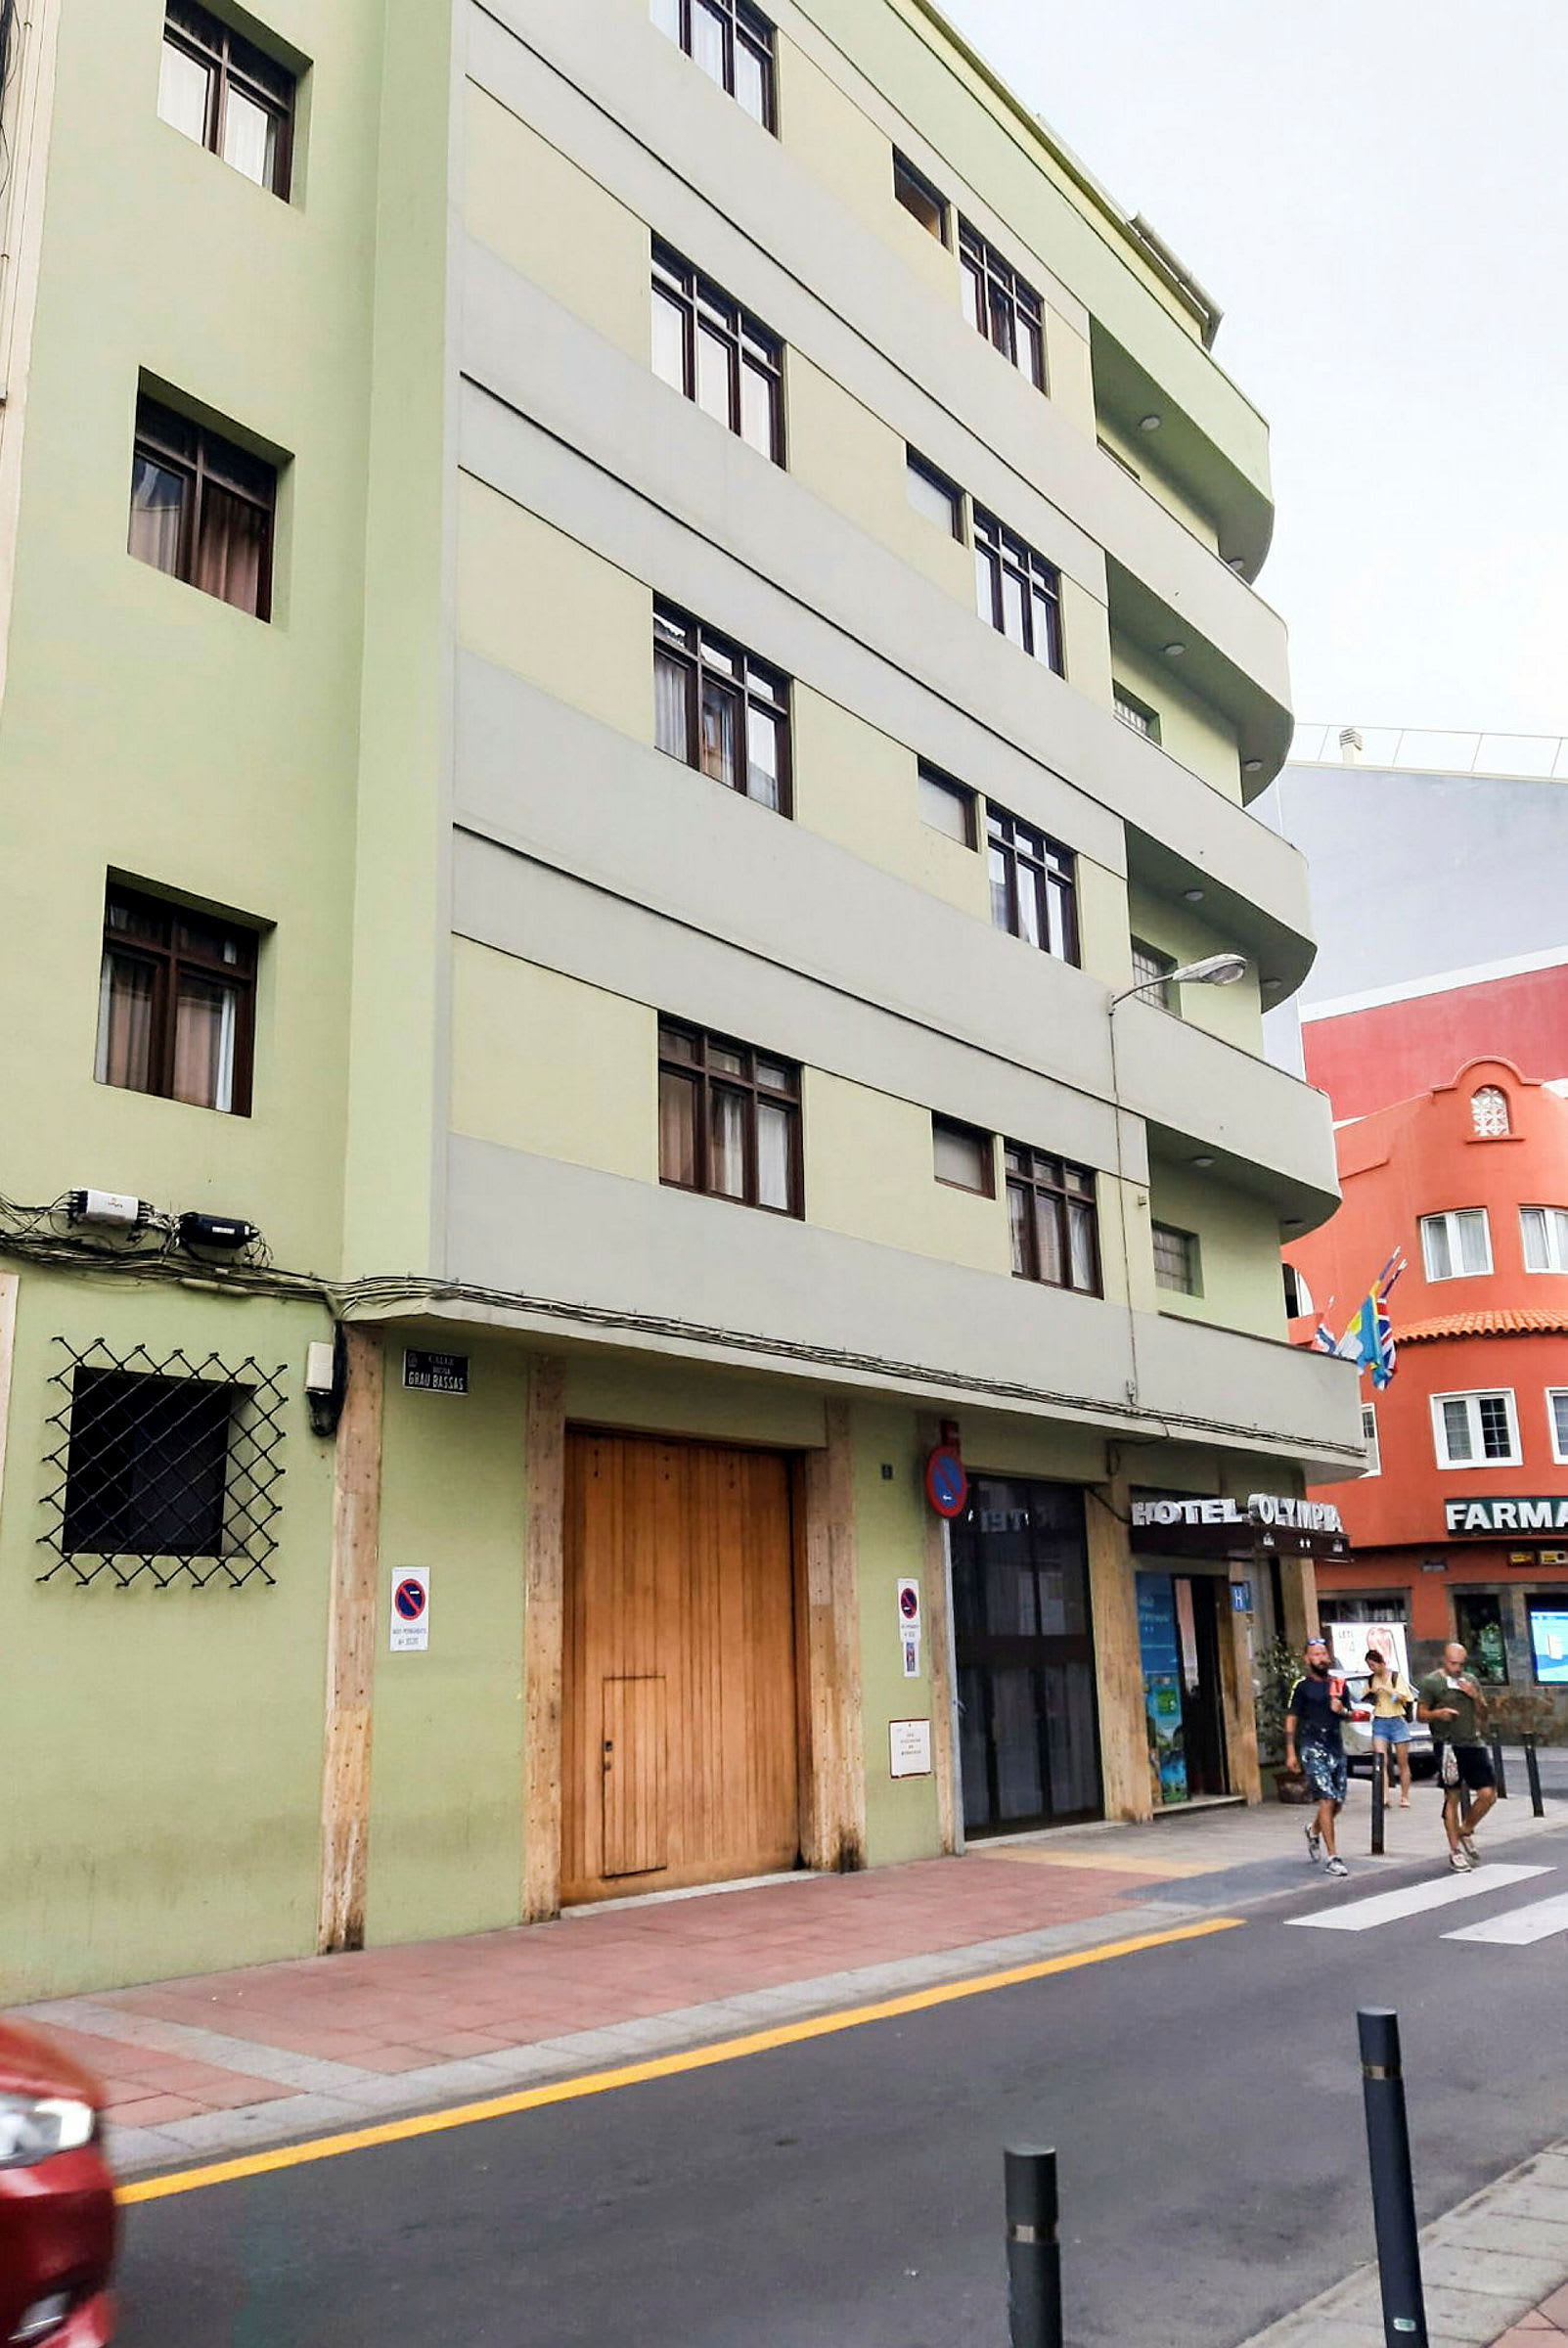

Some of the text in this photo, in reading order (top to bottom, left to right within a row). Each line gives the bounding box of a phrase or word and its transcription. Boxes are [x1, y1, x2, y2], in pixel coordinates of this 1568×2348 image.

[408, 1371, 430, 1387] GRAU
[432, 1374, 464, 1390] BASSAS
[1131, 1493, 1344, 1533] HOTEL OLYMPIA
